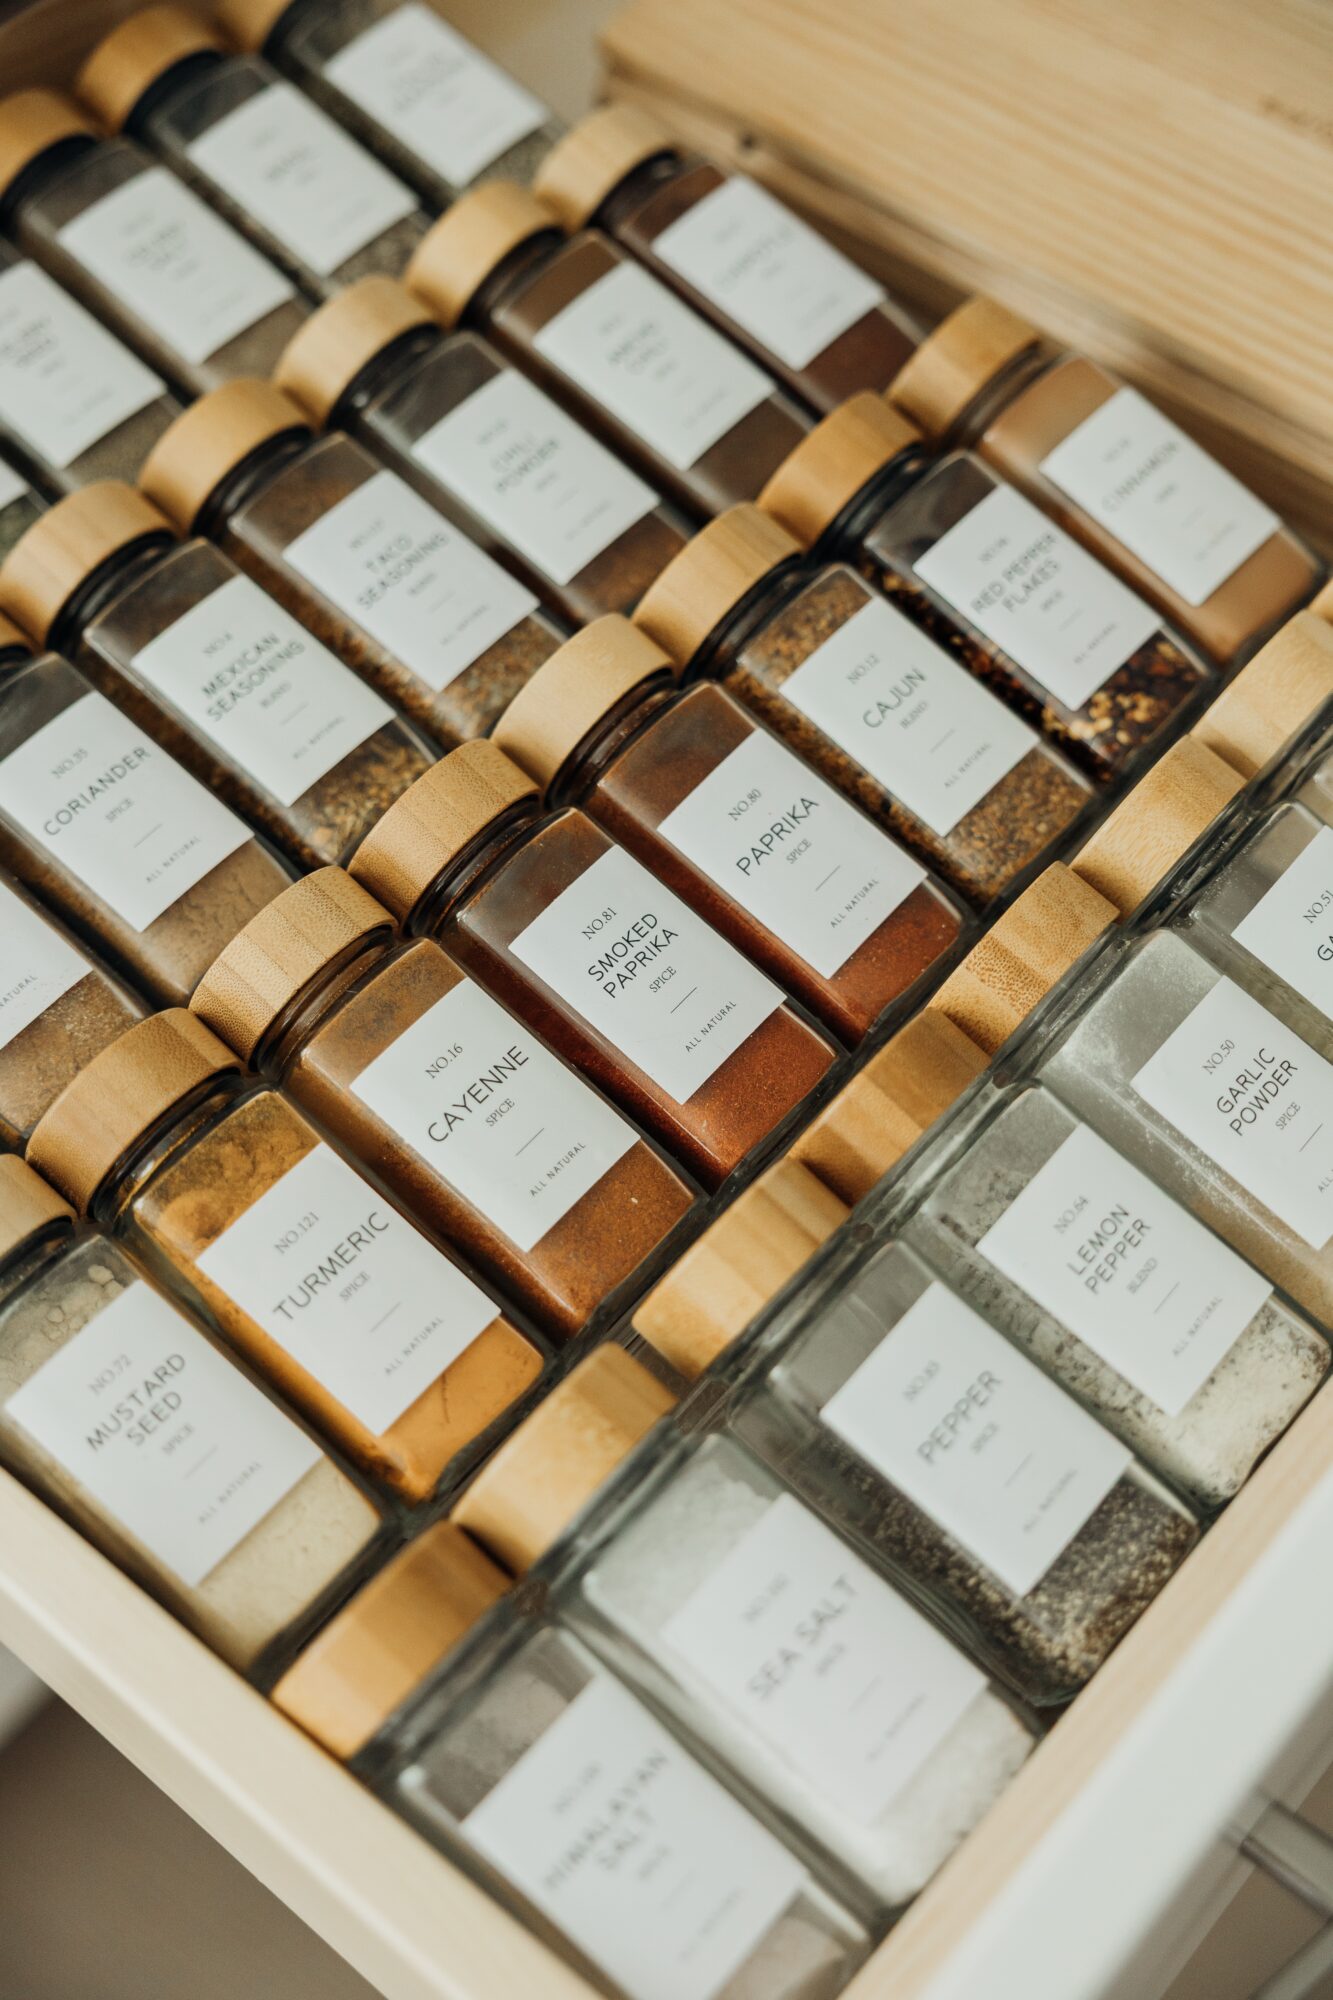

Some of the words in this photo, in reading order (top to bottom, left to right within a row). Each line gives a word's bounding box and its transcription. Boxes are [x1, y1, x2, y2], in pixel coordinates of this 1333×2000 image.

[356, 532, 450, 611] SEASONING
[364, 534, 413, 573] TACO
[969, 580, 1006, 615] RED
[1001, 533, 1057, 584] PEPPER
[1001, 557, 1061, 613] FLAKES
[201, 633, 280, 699] MEXICAN
[205, 640, 306, 722] SEASONING
[862, 667, 927, 729] CAJUN
[42, 746, 151, 837] CORIANDER
[727, 788, 763, 822] NO.80
[735, 797, 820, 877] PAPRIKA
[785, 837, 813, 865] SPICE
[580, 906, 618, 941] NO.81
[830, 913, 846, 928] ALL
[844, 879, 879, 912] NATURAL
[587, 912, 659, 982] SMOKED
[602, 928, 679, 999] PAPRIKA
[648, 965, 678, 994] SPICE
[685, 1037, 702, 1053] ALL
[700, 1001, 737, 1036] NATURAL
[1201, 1038, 1236, 1076] NO.50
[424, 1042, 464, 1080] NO.16
[1216, 1047, 1276, 1115] GARLIC
[427, 1045, 530, 1143] CAYENNE
[484, 1097, 516, 1128] SPICE
[1228, 1059, 1299, 1137] POWDER
[1274, 1100, 1302, 1131] SPICE
[529, 1181, 547, 1197] ALL
[546, 1142, 586, 1179] NATURAL
[273, 1211, 320, 1256] NO.121
[1066, 1203, 1131, 1277] LEMON
[1083, 1218, 1152, 1295] PEPPER
[272, 1211, 390, 1320] TURMERIC
[338, 1270, 371, 1303] SPICE
[384, 1358, 404, 1377] ALL
[402, 1317, 444, 1357] NATURAL
[85, 1353, 186, 1452] MUSTARD
[125, 1390, 183, 1447] SEED
[916, 1369, 1003, 1466] PEPPER
[747, 1647, 803, 1701] SEA
[794, 1573, 857, 1647] SALT
